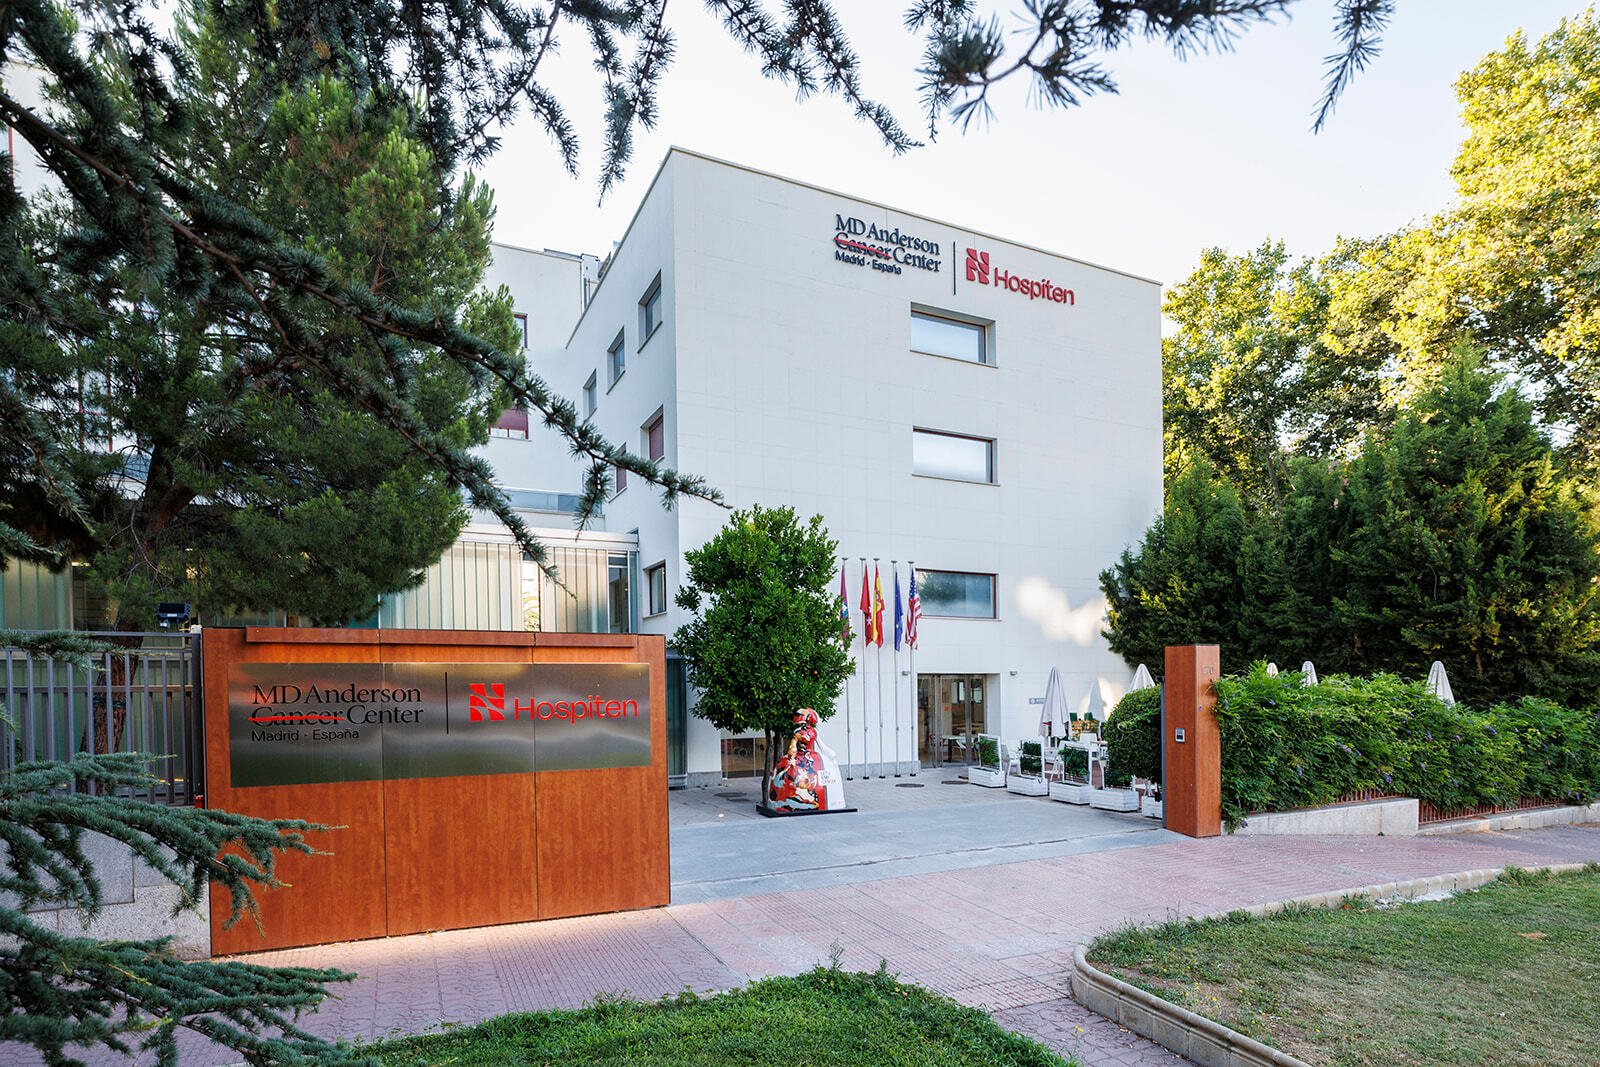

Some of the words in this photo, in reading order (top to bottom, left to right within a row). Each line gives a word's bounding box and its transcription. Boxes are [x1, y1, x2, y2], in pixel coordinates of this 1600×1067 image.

[836, 214, 866, 236] MD
[867, 222, 940, 256] Anderson
[834, 232, 891, 260] Cancer
[893, 246, 942, 273] Center
[835, 251, 865, 266] Madrid
[872, 259, 901, 275] España
[994, 267, 1075, 305] Hospiten
[252, 684, 302, 704] MD
[303, 682, 421, 704] Anderson
[249, 706, 344, 726] Cancer
[346, 704, 424, 725] Center
[514, 694, 638, 724] Hospiten
[251, 729, 299, 742] Madrid
[312, 728, 359, 742] España
